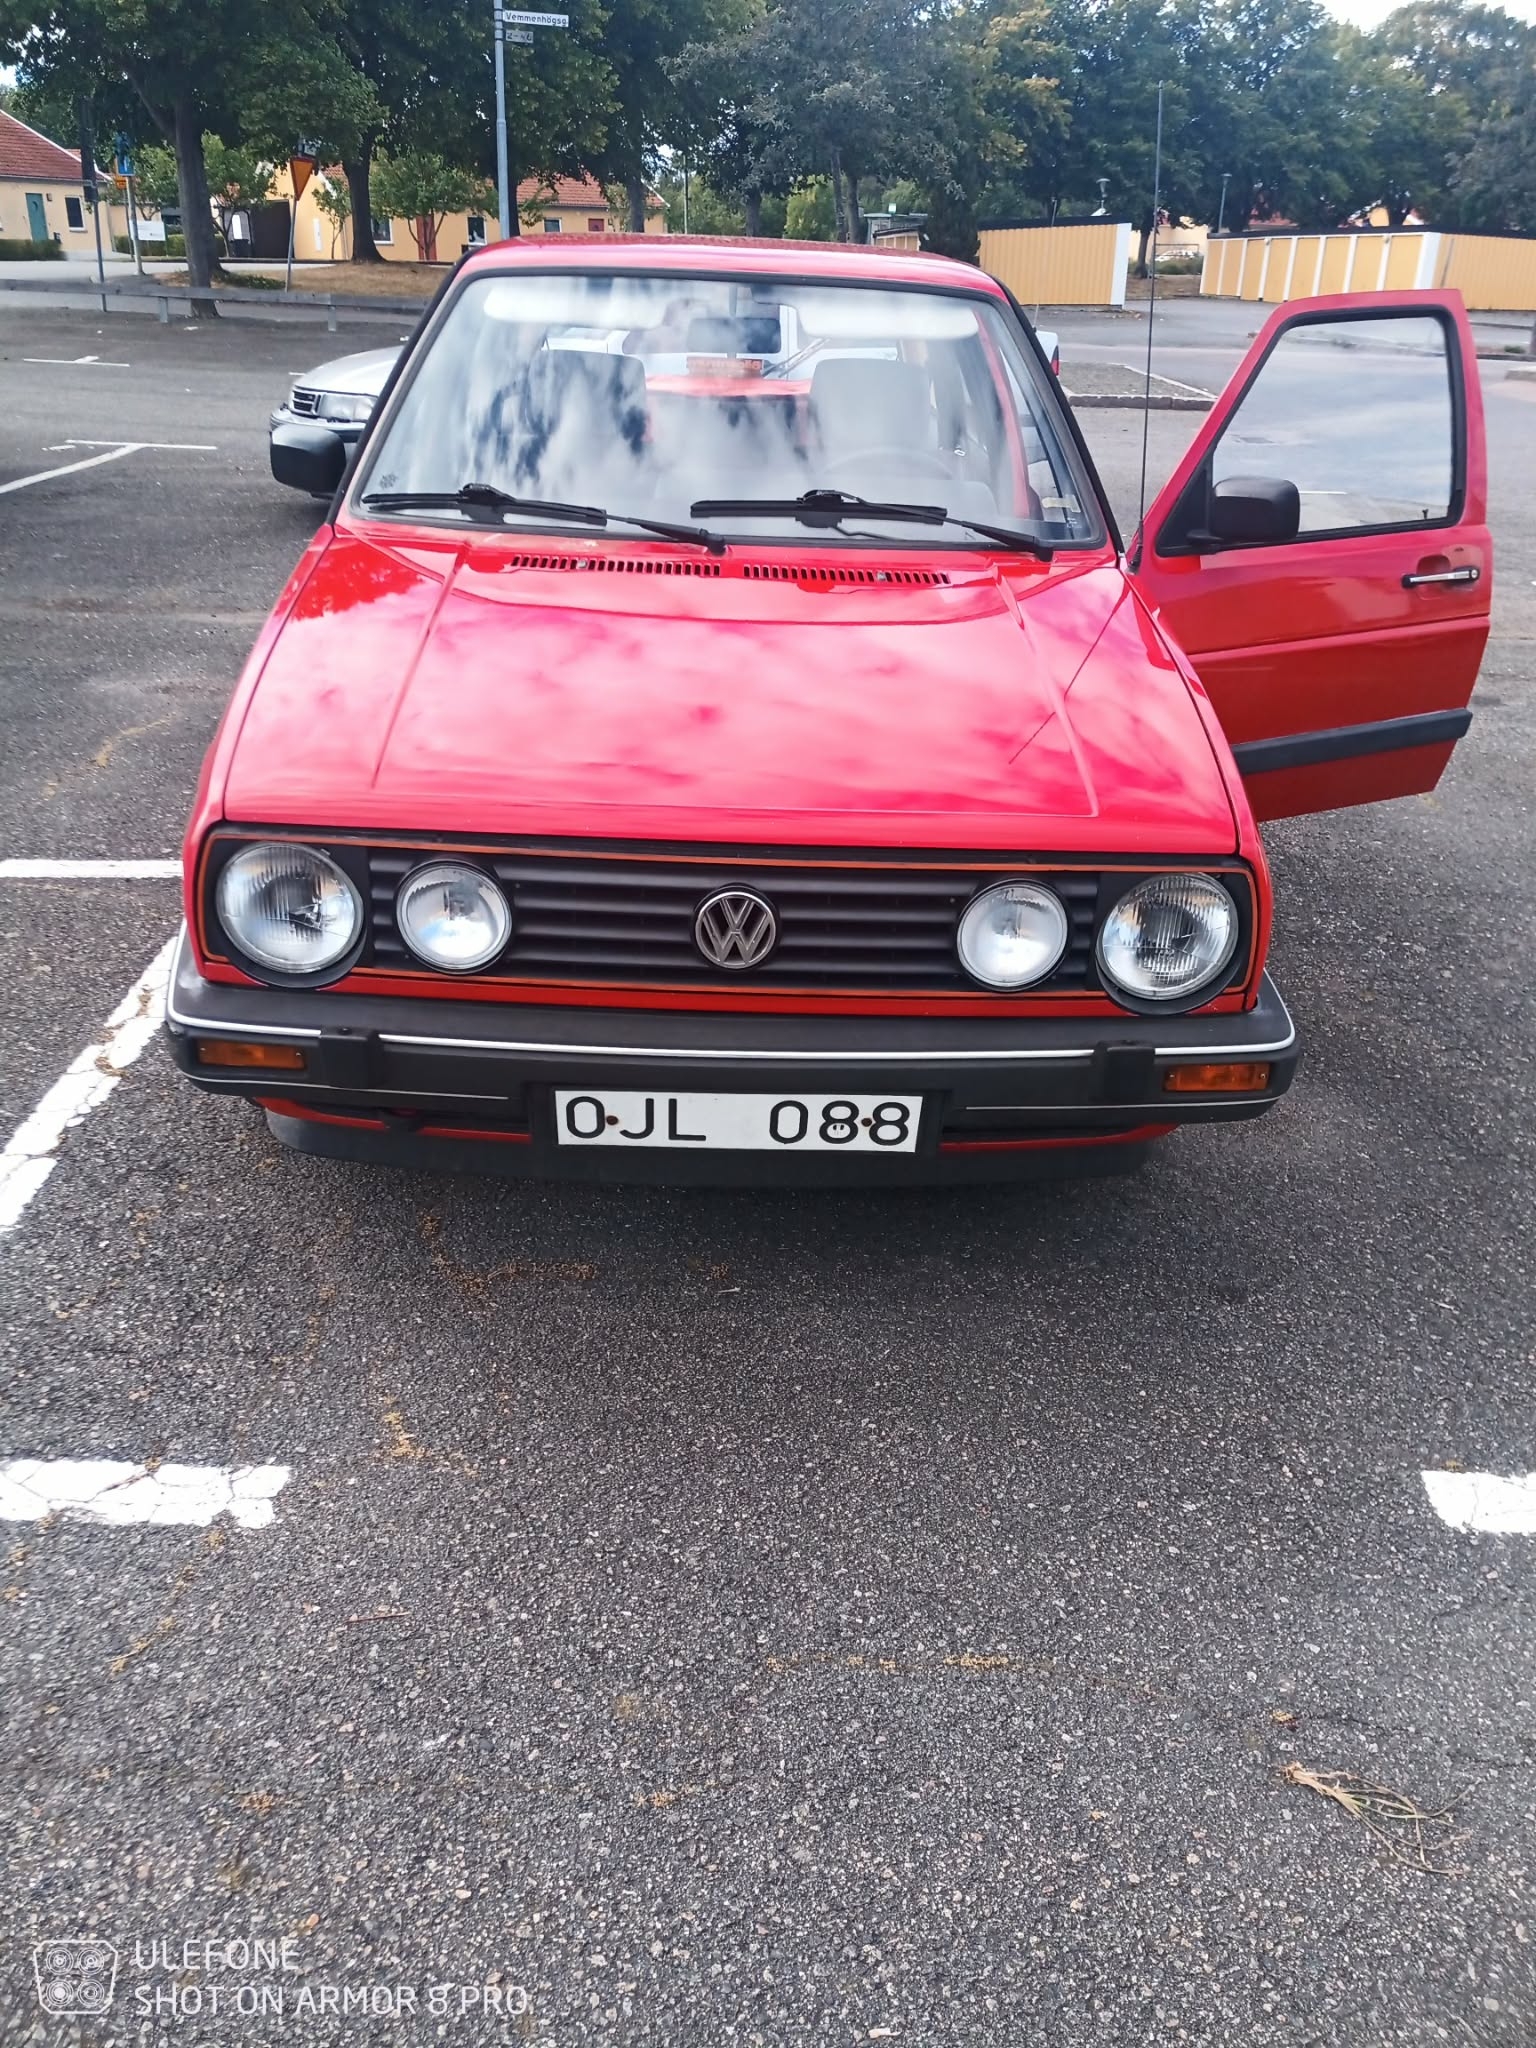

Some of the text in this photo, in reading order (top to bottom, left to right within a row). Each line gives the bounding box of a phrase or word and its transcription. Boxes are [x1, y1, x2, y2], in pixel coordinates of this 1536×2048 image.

[696, 891, 776, 969] VW
[566, 1096, 910, 1146] OJL 088
